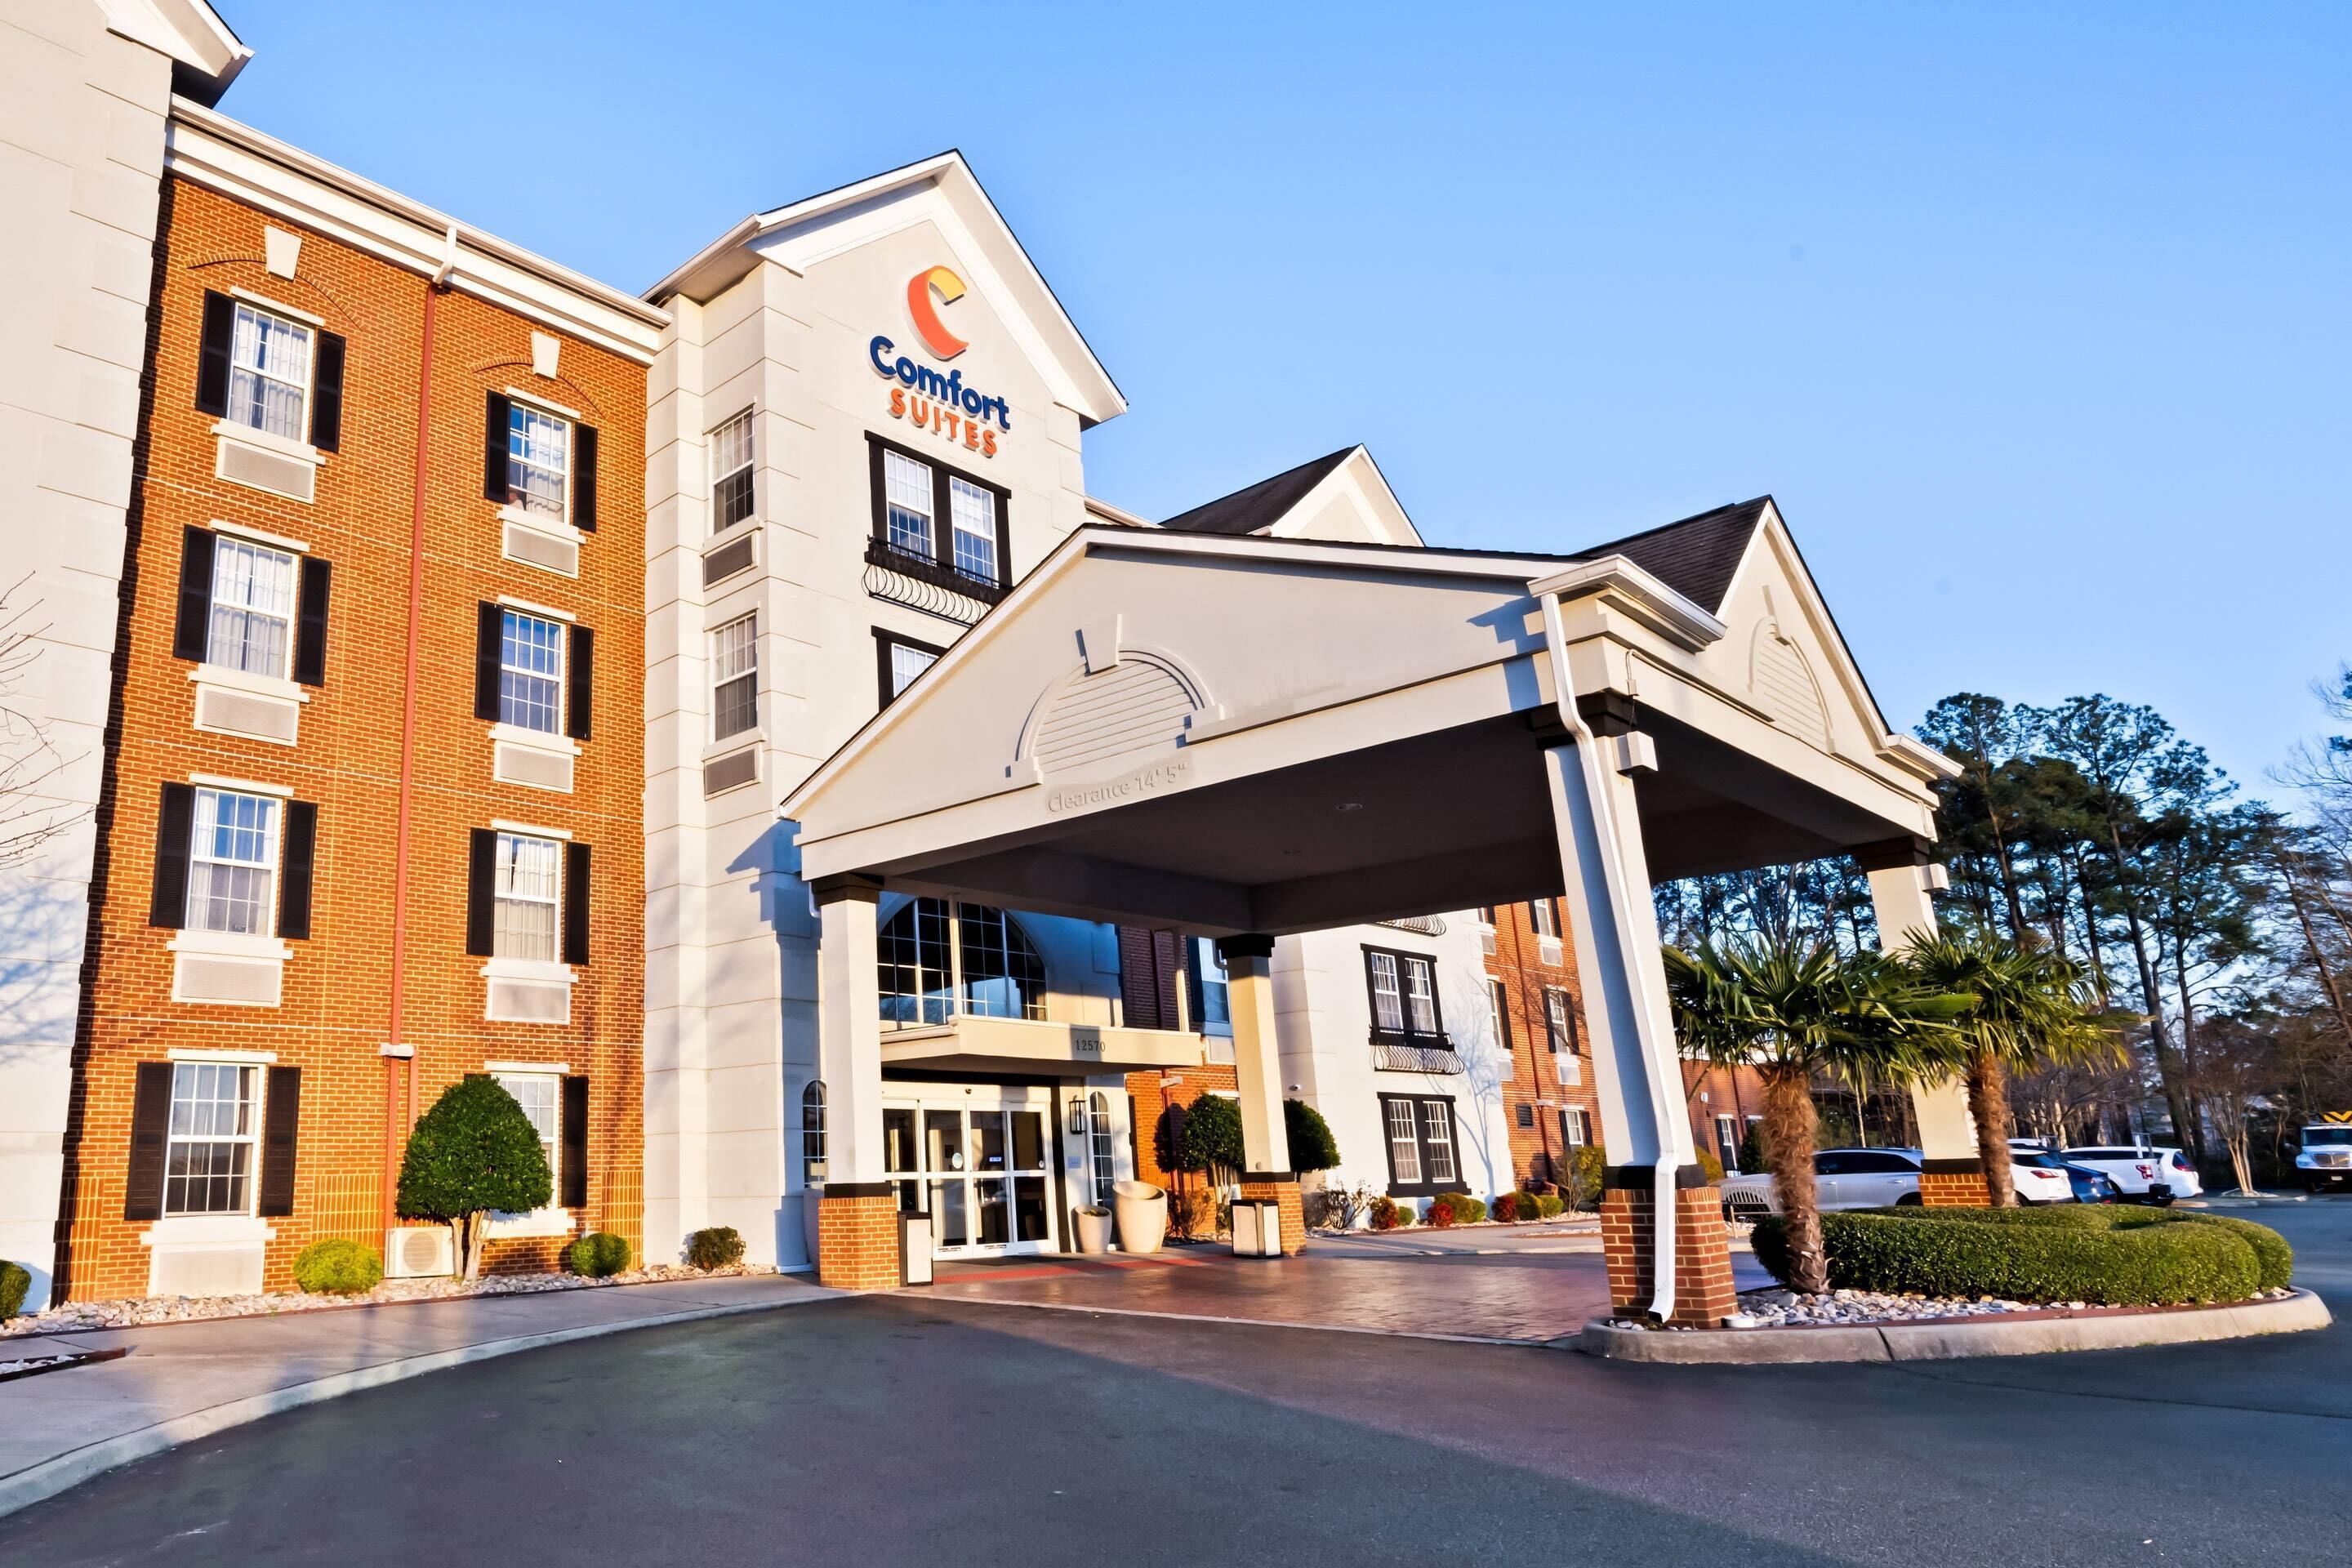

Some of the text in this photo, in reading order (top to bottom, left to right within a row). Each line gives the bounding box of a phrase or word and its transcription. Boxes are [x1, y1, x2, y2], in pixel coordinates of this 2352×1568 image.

[869, 335, 1011, 432] Comfort
[889, 388, 997, 457] SUITES
[1047, 782, 1131, 813] Clearance
[1076, 1039, 1106, 1053] 12570
